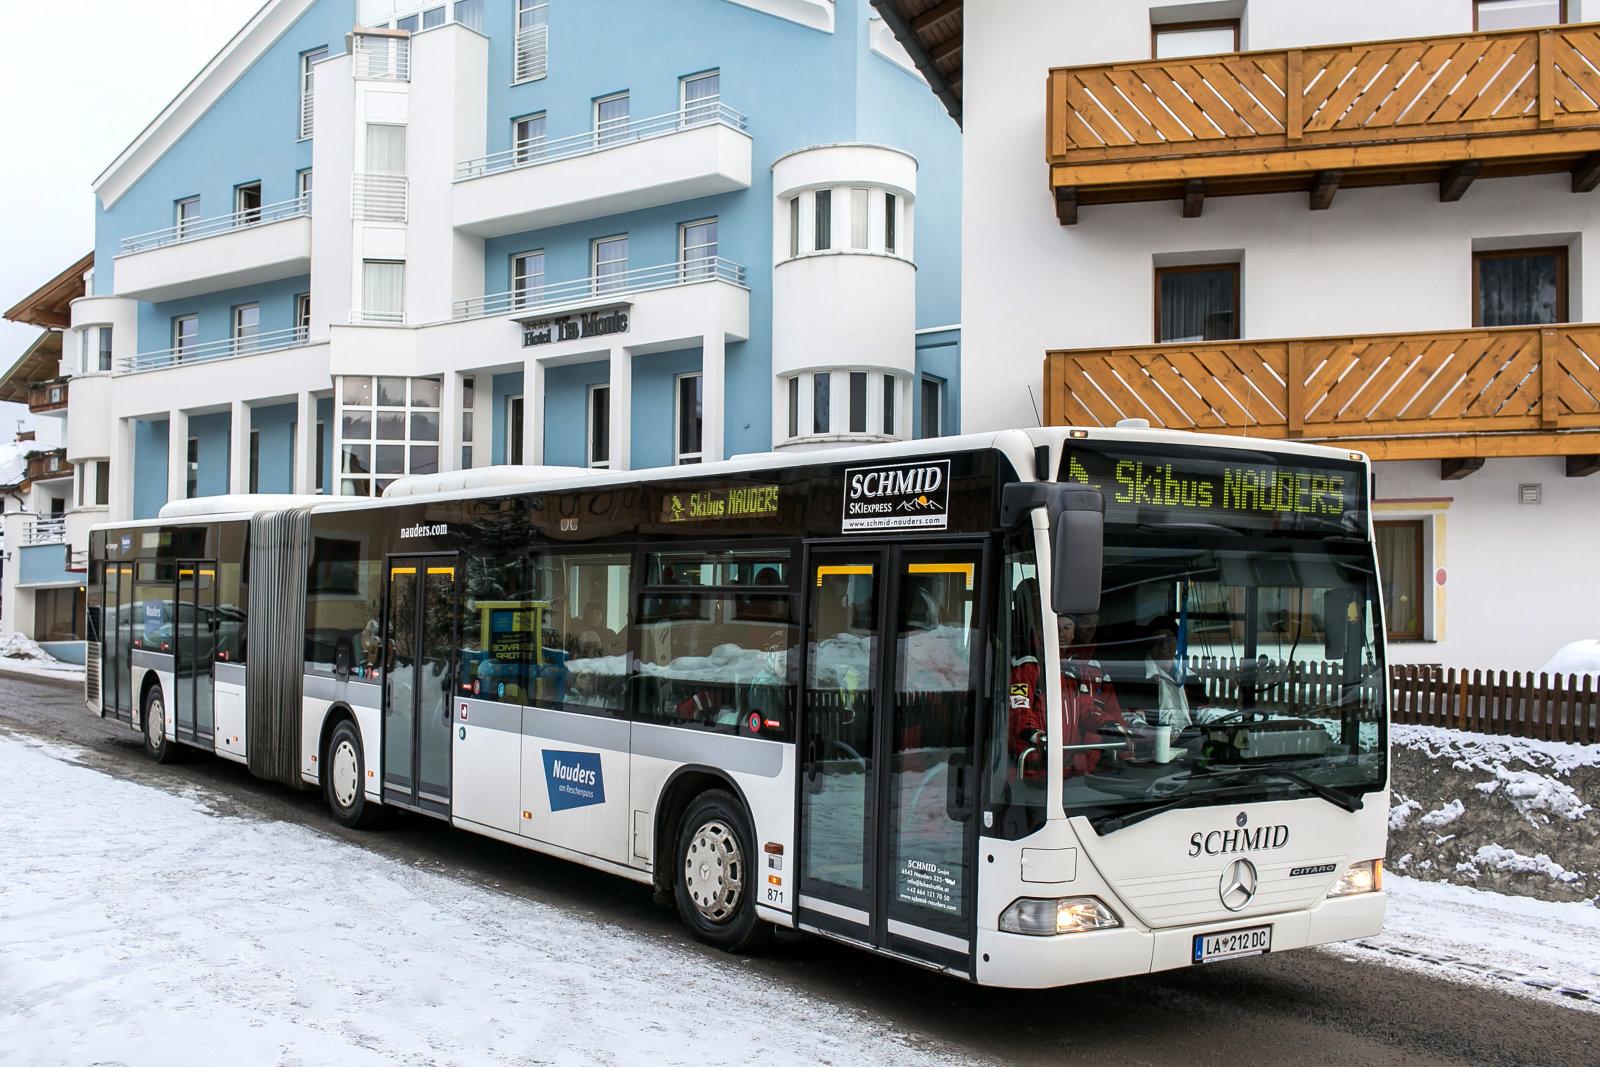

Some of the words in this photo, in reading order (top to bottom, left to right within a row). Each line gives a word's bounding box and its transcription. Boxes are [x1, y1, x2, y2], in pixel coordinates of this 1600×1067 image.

[524, 329, 552, 346] Hotel
[555, 315, 579, 341] Tia
[580, 310, 628, 338] Monte
[850, 467, 942, 499] SCHMID
[1115, 460, 1213, 507] Skibus
[1223, 468, 1344, 514] NAUDERS
[690, 492, 725, 516] Skibus
[728, 486, 779, 514] NAUDERS
[400, 523, 448, 538] nauders.com
[849, 517, 941, 528] www.schmid-nauders.com
[146, 606, 161, 617] Nauders
[552, 759, 596, 786] Nauders
[565, 784, 594, 799] Reschenpass
[1188, 824, 1289, 858] SCHMID
[908, 860, 936, 872] SCHMID
[1292, 865, 1334, 875] CITARO
[914, 871, 932, 880] Nauders
[907, 878, 949, 892] info@bikeshuttle.at
[767, 887, 783, 903] 871
[901, 894, 956, 910] www.schmid-nauders.com
[1206, 938, 1221, 955] LA
[1229, 933, 1250, 951] 212
[1251, 930, 1266, 948] DC
